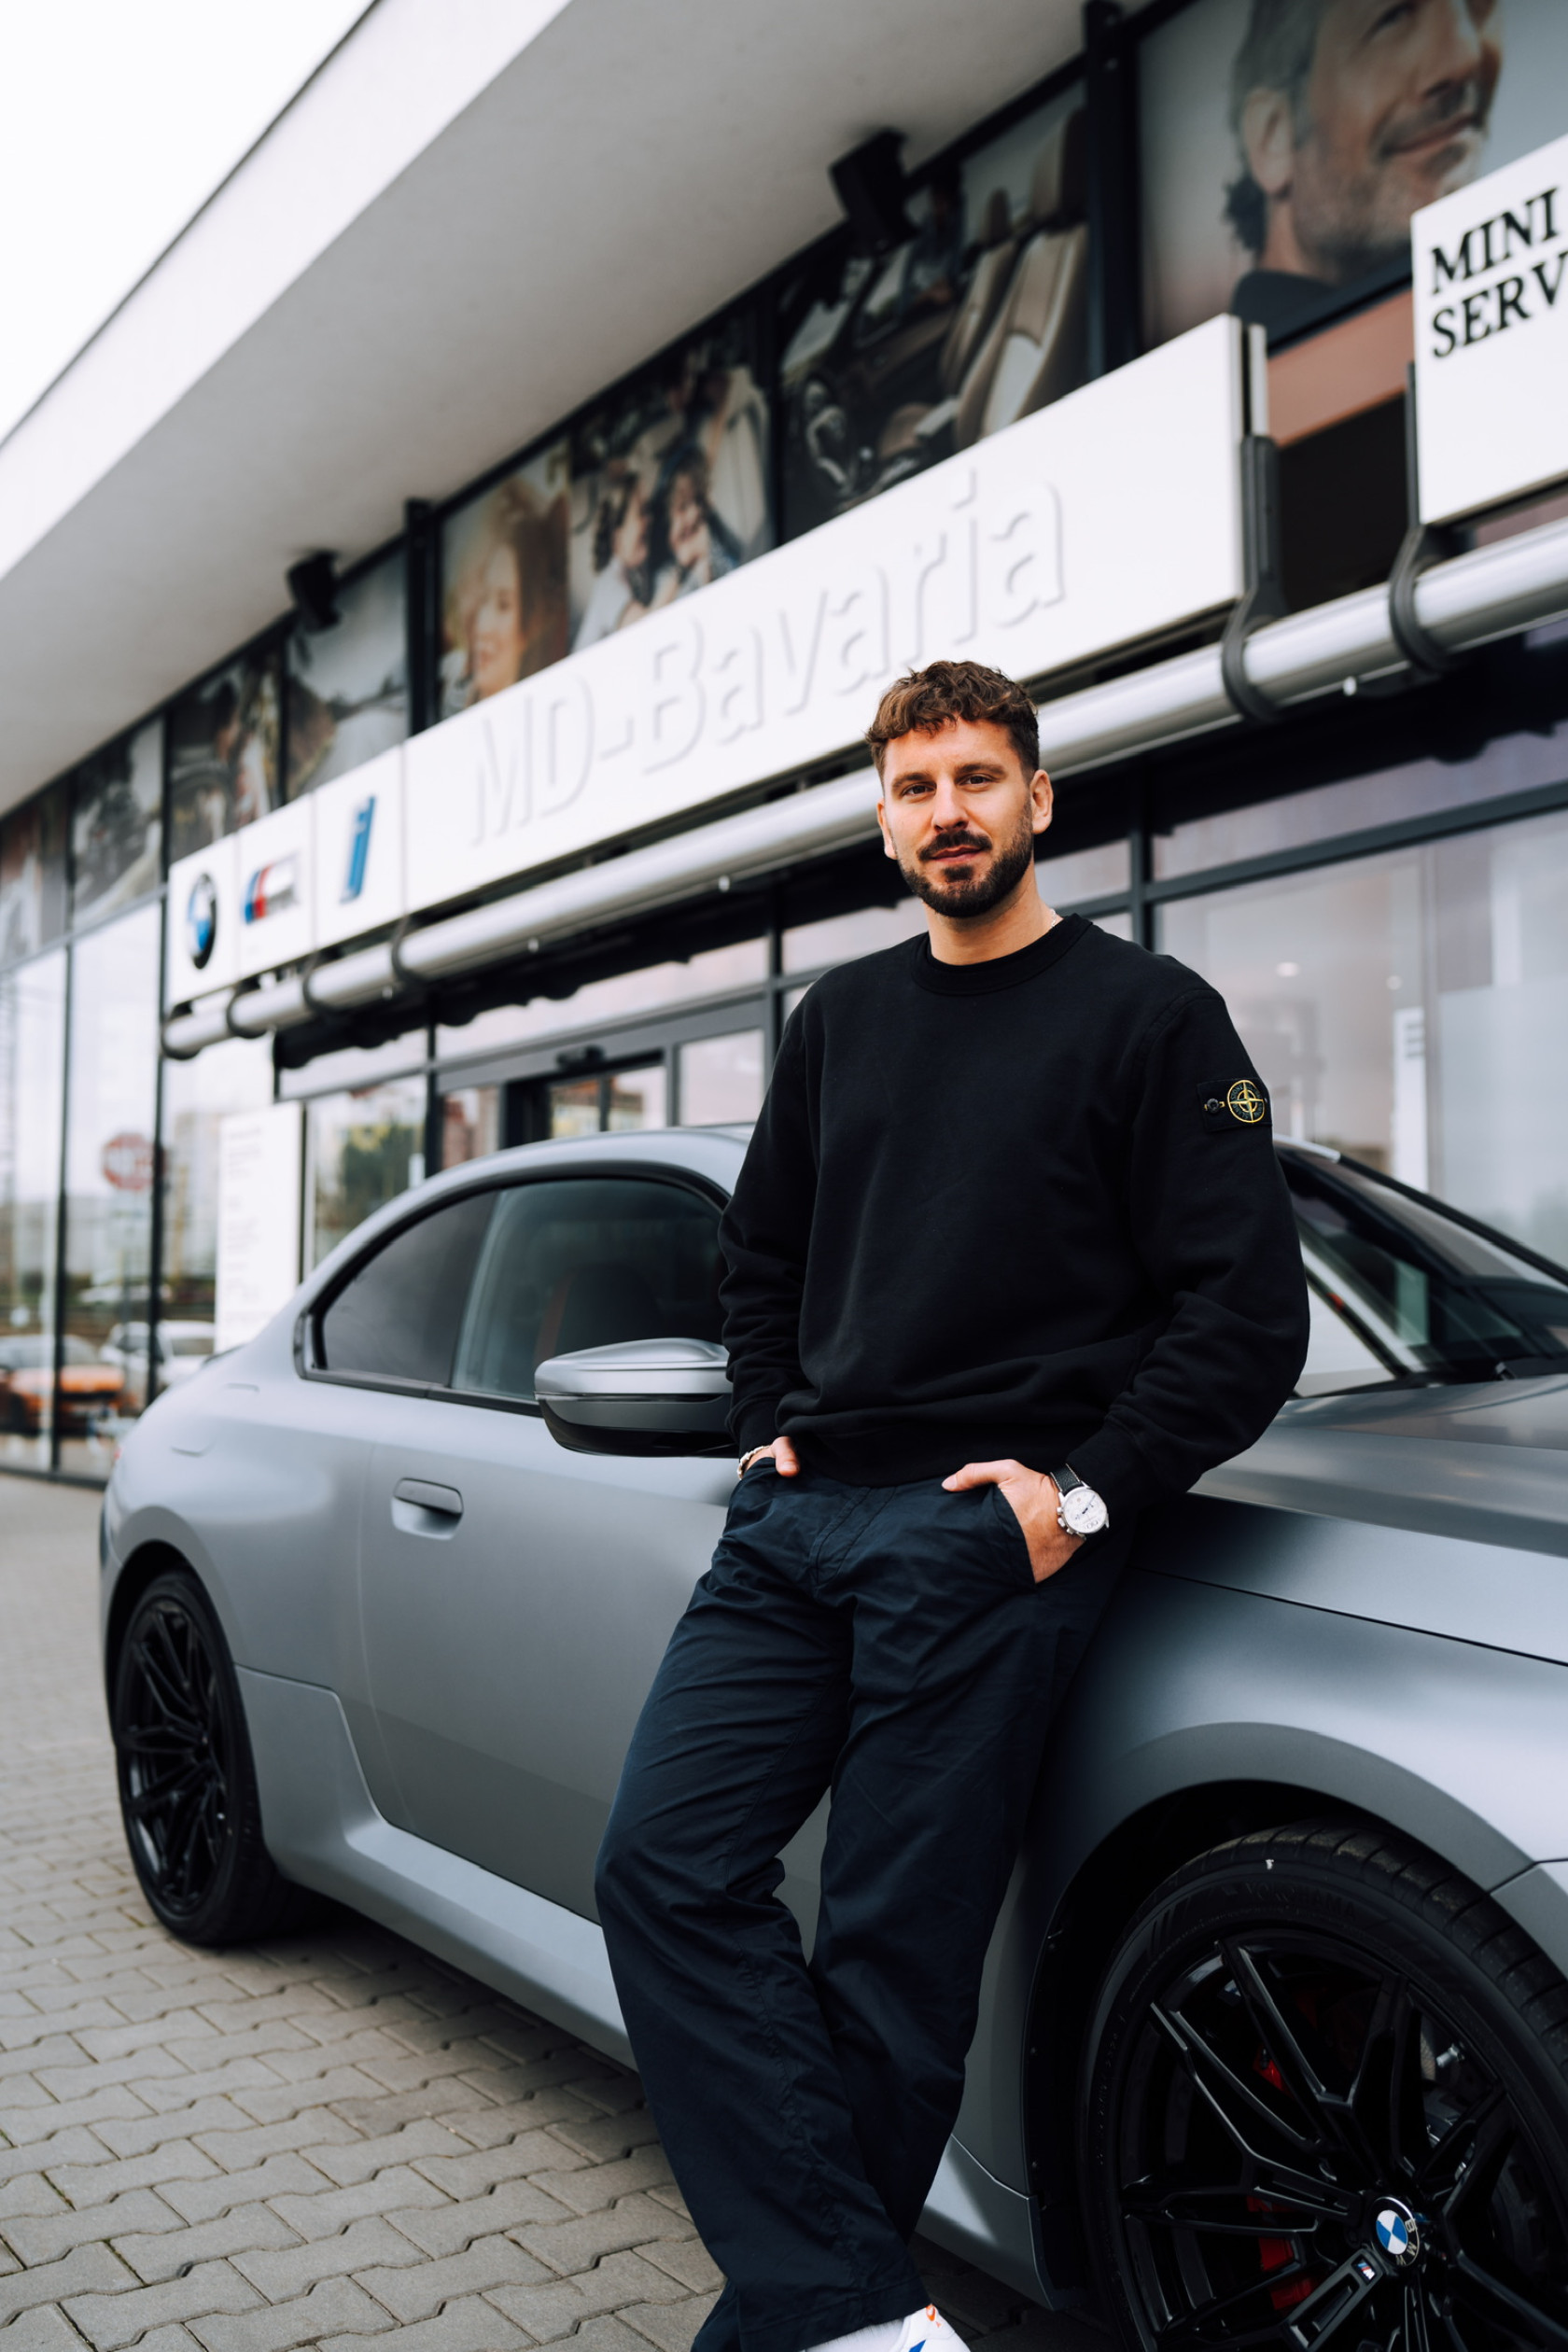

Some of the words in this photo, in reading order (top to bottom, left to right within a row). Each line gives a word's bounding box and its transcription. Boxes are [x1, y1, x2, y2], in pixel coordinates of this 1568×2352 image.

[1430, 186, 1560, 295] MINI
[1432, 251, 1568, 358] SERV
[469, 465, 1068, 847] MD-Bavaria
[1396, 2219, 1417, 2265] BMW
